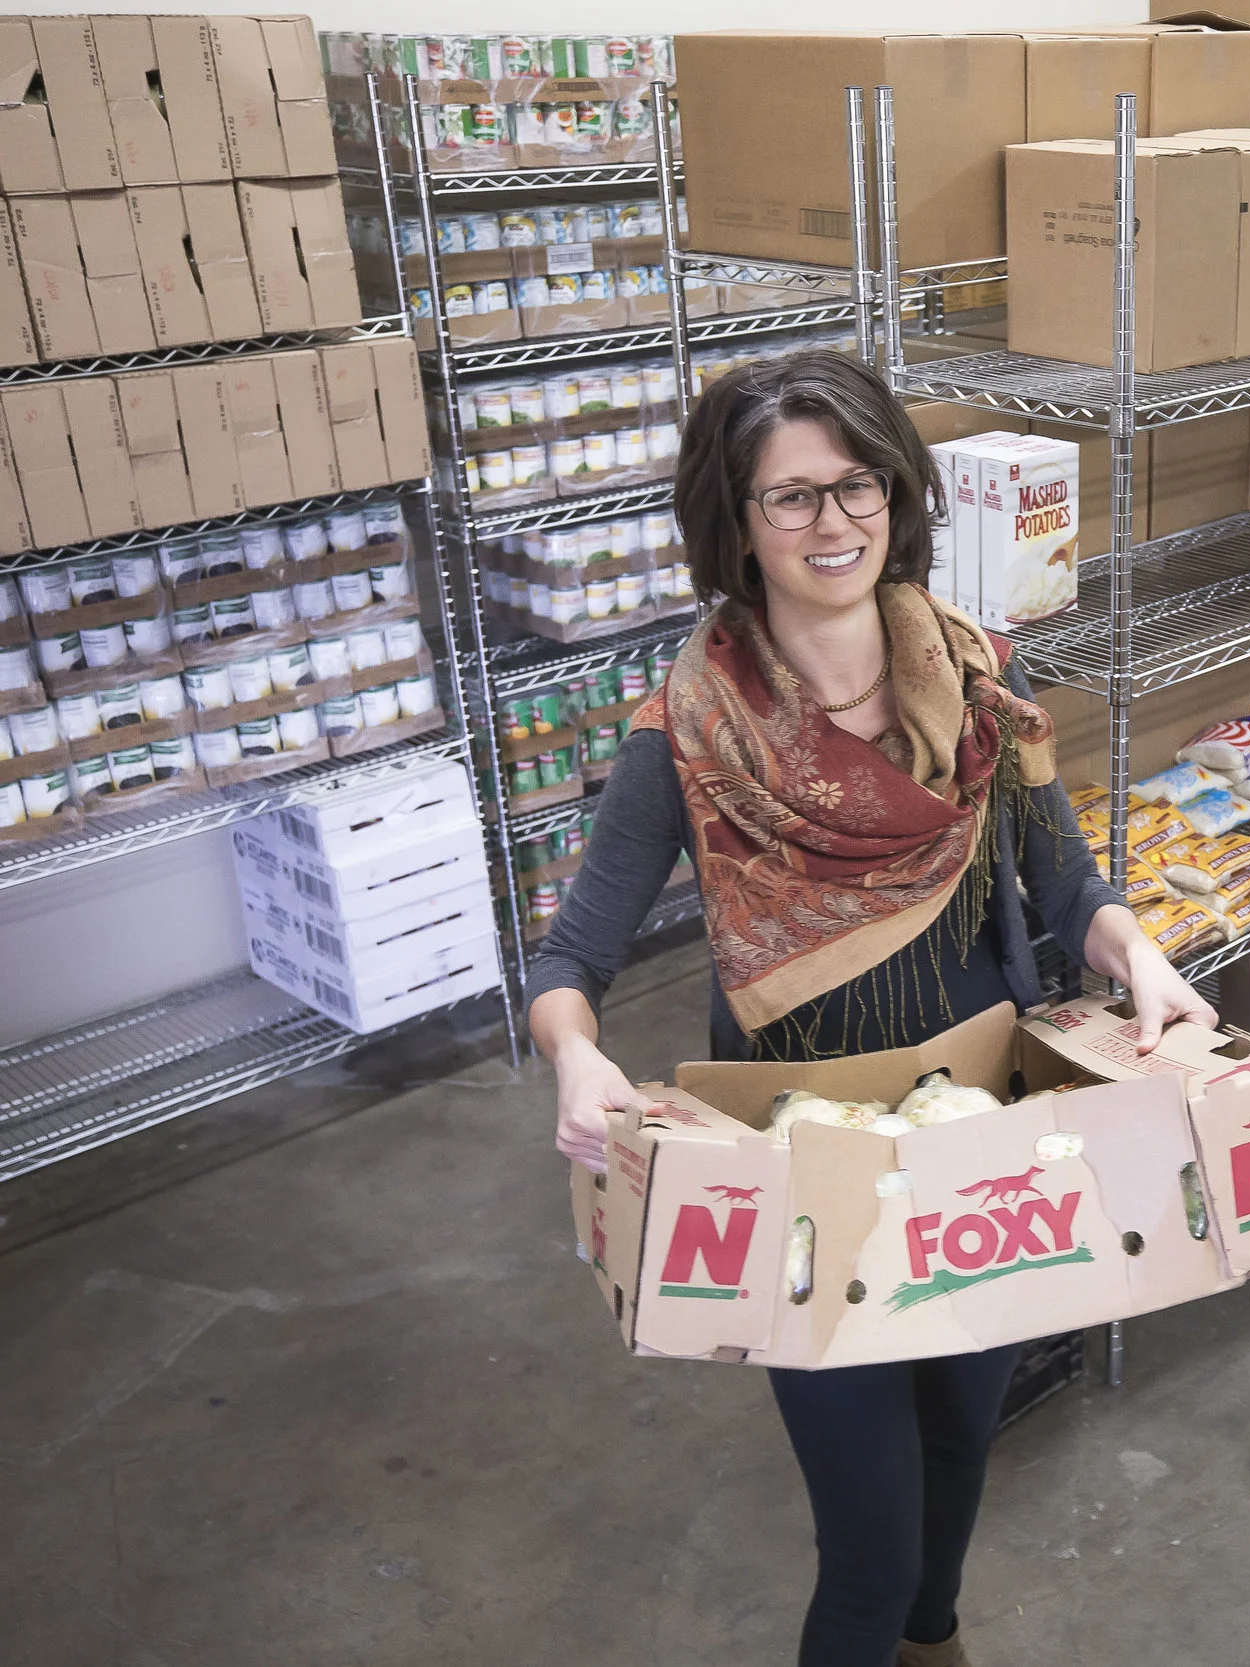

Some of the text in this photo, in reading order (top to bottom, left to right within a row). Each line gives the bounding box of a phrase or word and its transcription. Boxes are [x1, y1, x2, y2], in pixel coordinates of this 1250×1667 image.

[1018, 480, 1068, 514] MASHED
[1014, 505, 1071, 541] POTATOES
[1136, 834, 1167, 853] BROWN
[1210, 849, 1239, 869] BROWN
[1156, 920, 1188, 943] BROWN
[1047, 1008, 1086, 1030] FOXY
[660, 1204, 758, 1283] N
[906, 1191, 1085, 1279] FOXY
